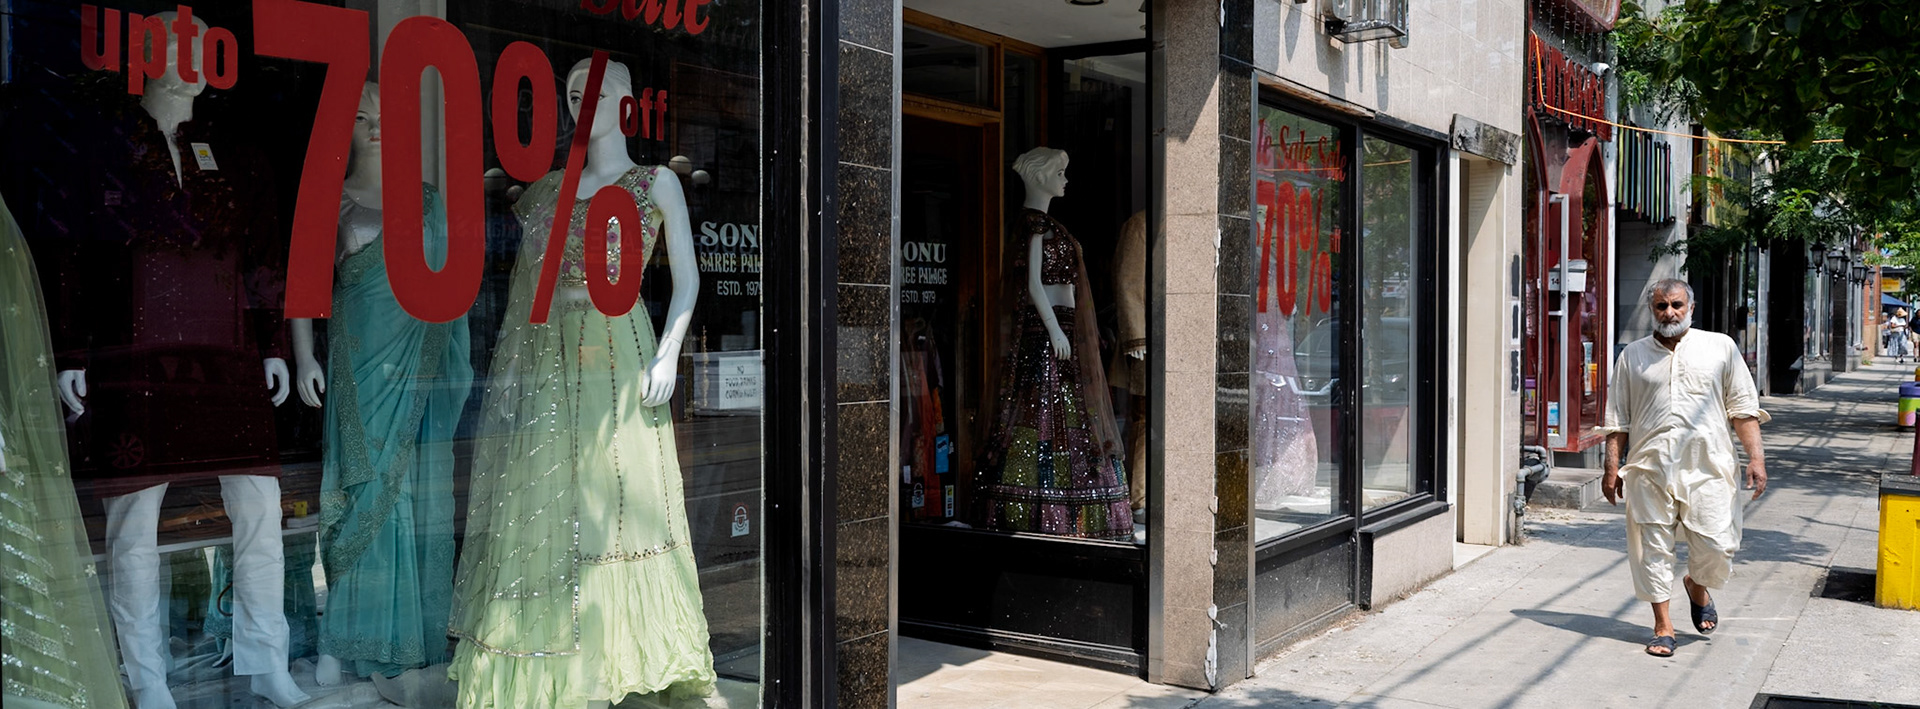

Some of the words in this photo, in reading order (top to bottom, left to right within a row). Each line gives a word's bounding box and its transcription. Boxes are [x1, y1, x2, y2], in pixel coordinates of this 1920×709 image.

[81, 4, 239, 95] upto
[252, 0, 643, 324] 70%
[619, 87, 668, 141] off
[1256, 118, 1272, 166] le
[1277, 125, 1312, 175] Sale
[1316, 136, 1347, 182] Sale
[700, 220, 759, 249] SON
[902, 240, 947, 264] ONU
[1256, 180, 1332, 316] 70%
[700, 252, 737, 273] SAREE
[740, 253, 760, 274] PAL
[901, 265, 917, 285] REE
[918, 267, 948, 285] PALACE
[716, 280, 743, 296] ESTD.
[922, 290, 936, 304] 1979
